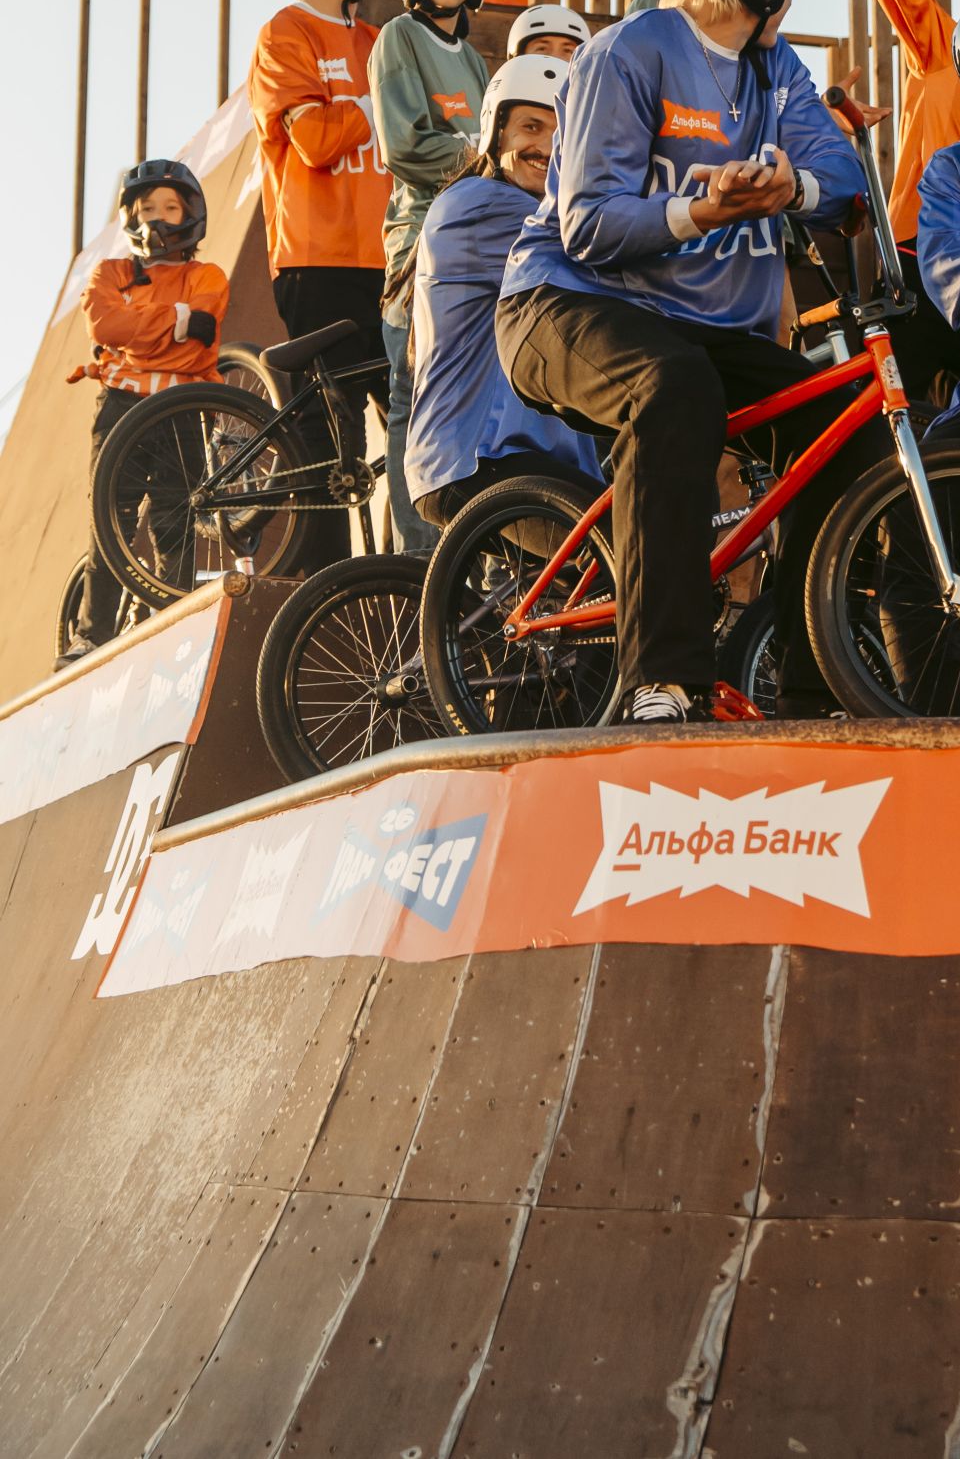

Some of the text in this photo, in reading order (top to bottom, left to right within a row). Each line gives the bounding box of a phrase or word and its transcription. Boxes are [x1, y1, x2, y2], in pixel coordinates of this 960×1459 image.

[670, 114, 700, 130] Альфа
[126, 565, 169, 599] MAXXIS
[445, 703, 470, 736] XXIS
[380, 807, 416, 833] 26
[612, 820, 842, 870] Альфа Банк
[384, 836, 477, 908] ФЕСТ
